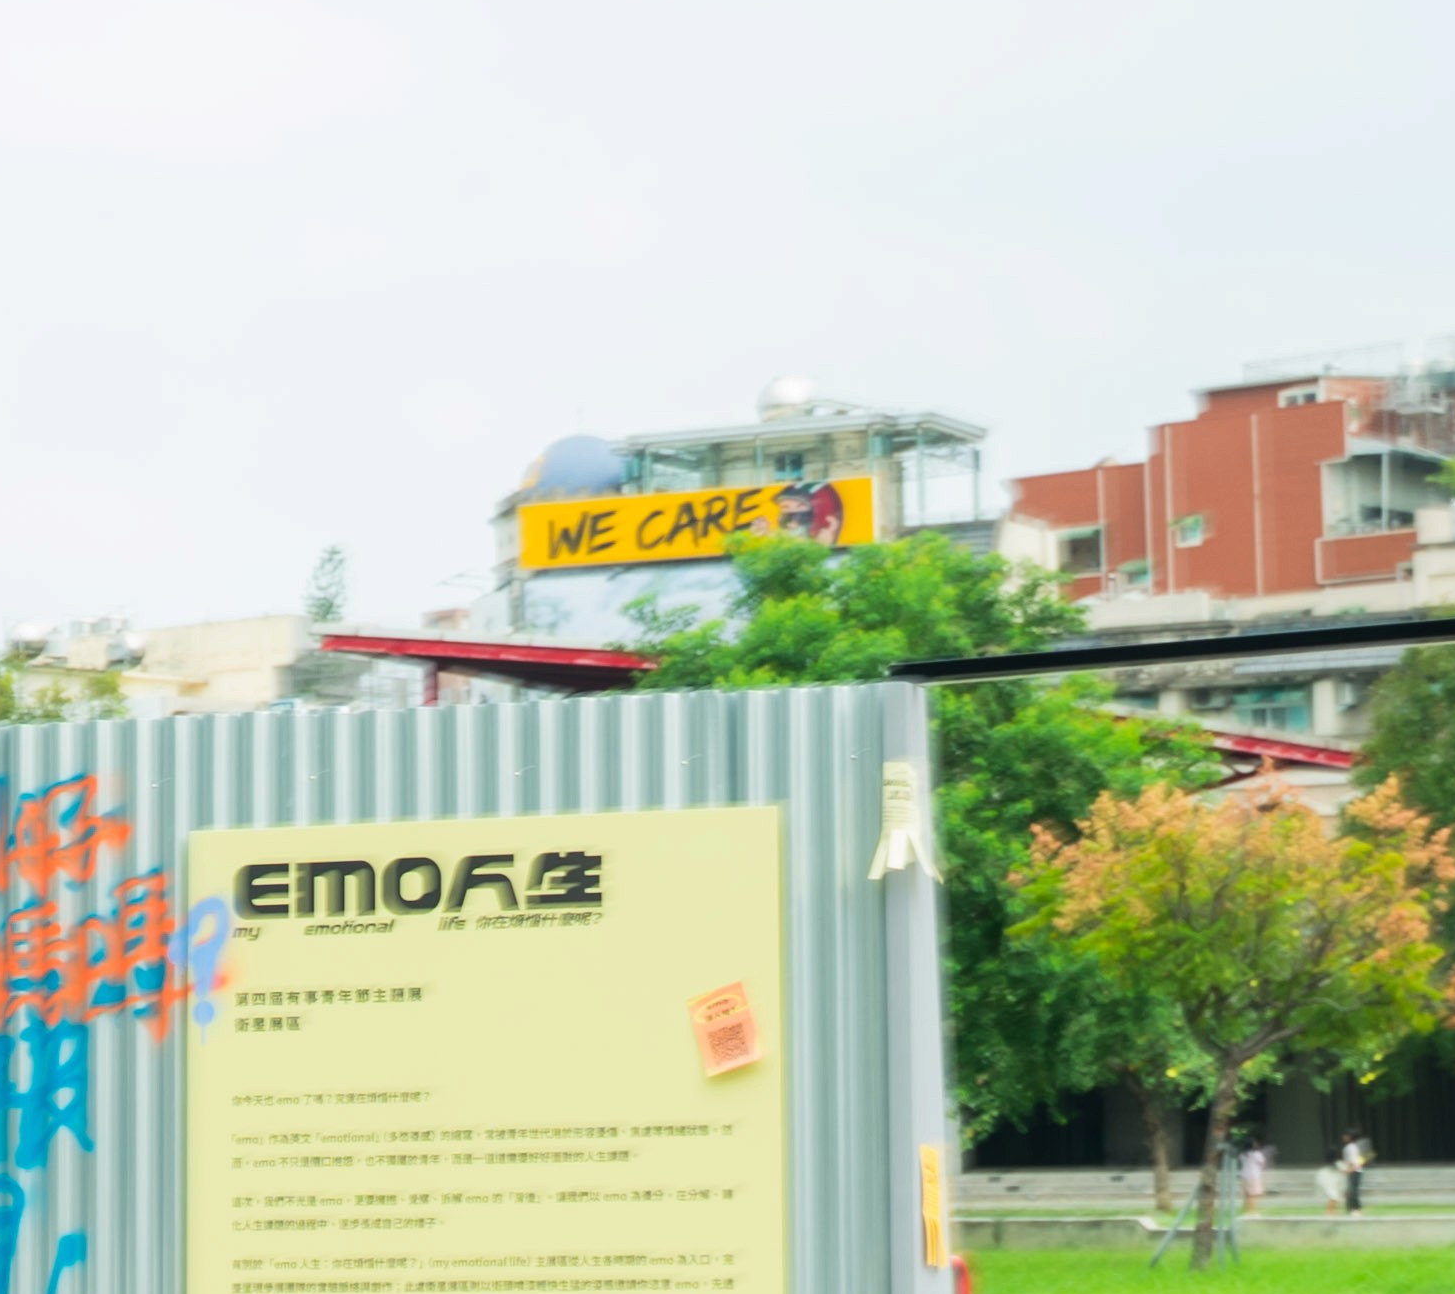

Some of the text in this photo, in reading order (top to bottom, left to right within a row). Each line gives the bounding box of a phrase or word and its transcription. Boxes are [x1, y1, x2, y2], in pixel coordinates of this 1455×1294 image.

[547, 488, 764, 560] WE CARE
[232, 924, 261, 941] my
